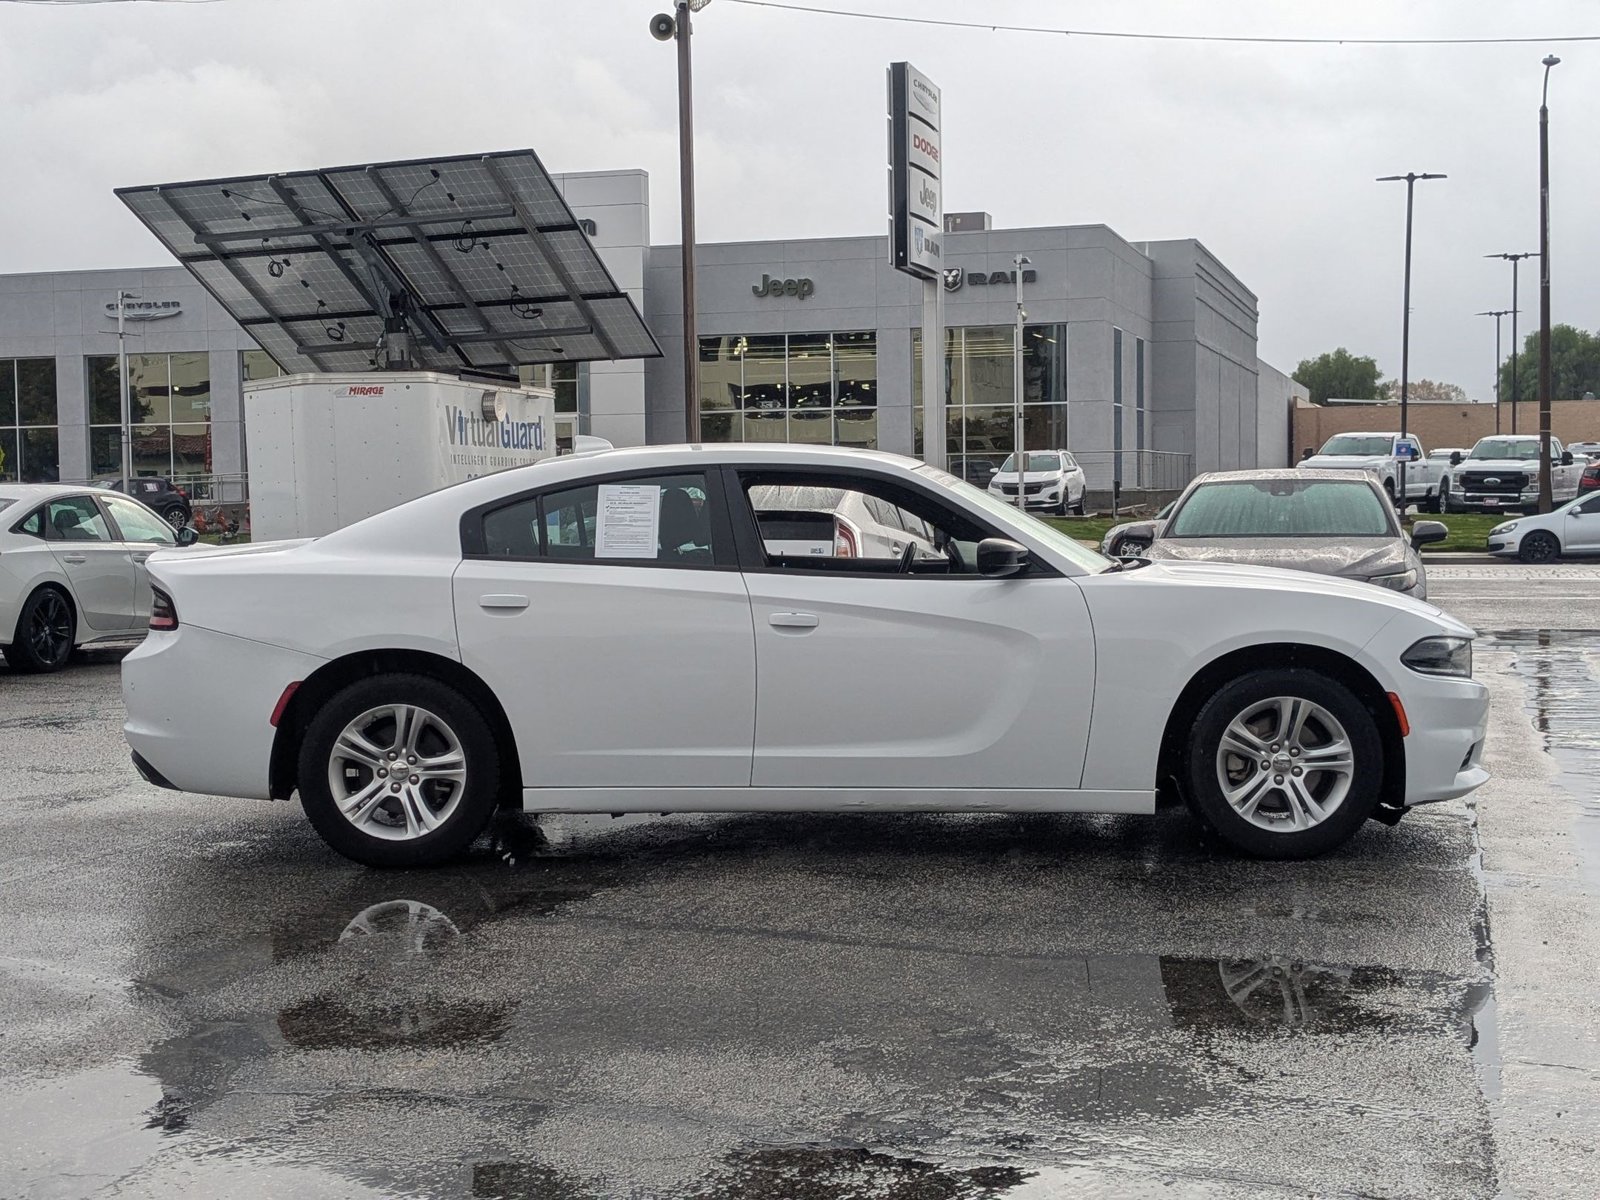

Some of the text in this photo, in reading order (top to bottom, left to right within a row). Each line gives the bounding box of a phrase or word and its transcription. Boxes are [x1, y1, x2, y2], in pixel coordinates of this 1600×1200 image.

[913, 133, 938, 163] DODGE
[919, 178, 937, 217] Jeep
[924, 237, 939, 258] RAM
[752, 274, 814, 300] Jeep
[967, 270, 1036, 285] RAM
[348, 386, 384, 395] MIRAGE
[445, 405, 543, 451] VirtualGuard
[450, 454, 487, 466] INTELLIGENT
[490, 456, 517, 467] GUARDING
